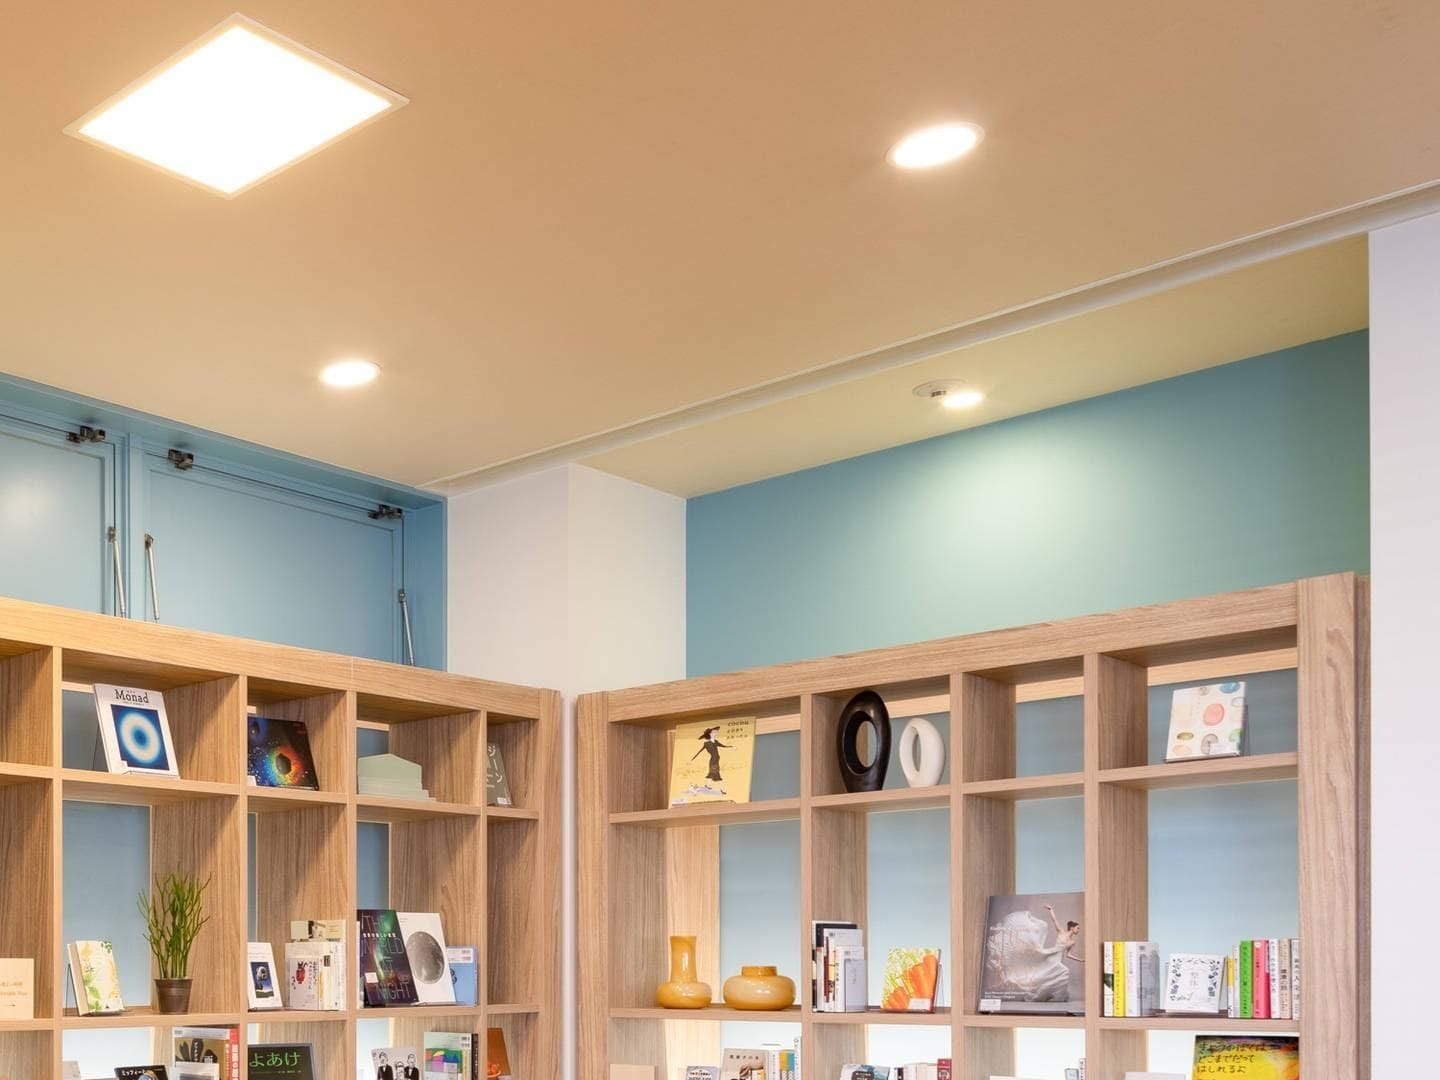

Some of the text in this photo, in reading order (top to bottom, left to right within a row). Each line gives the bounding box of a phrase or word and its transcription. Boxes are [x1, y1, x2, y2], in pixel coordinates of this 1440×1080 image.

[114, 688, 149, 703] Monad
[249, 1052, 301, 1067] よあけ
[1198, 1054, 1256, 1064] どこまでだって
[1196, 1064, 1246, 1073] はしれるよ
